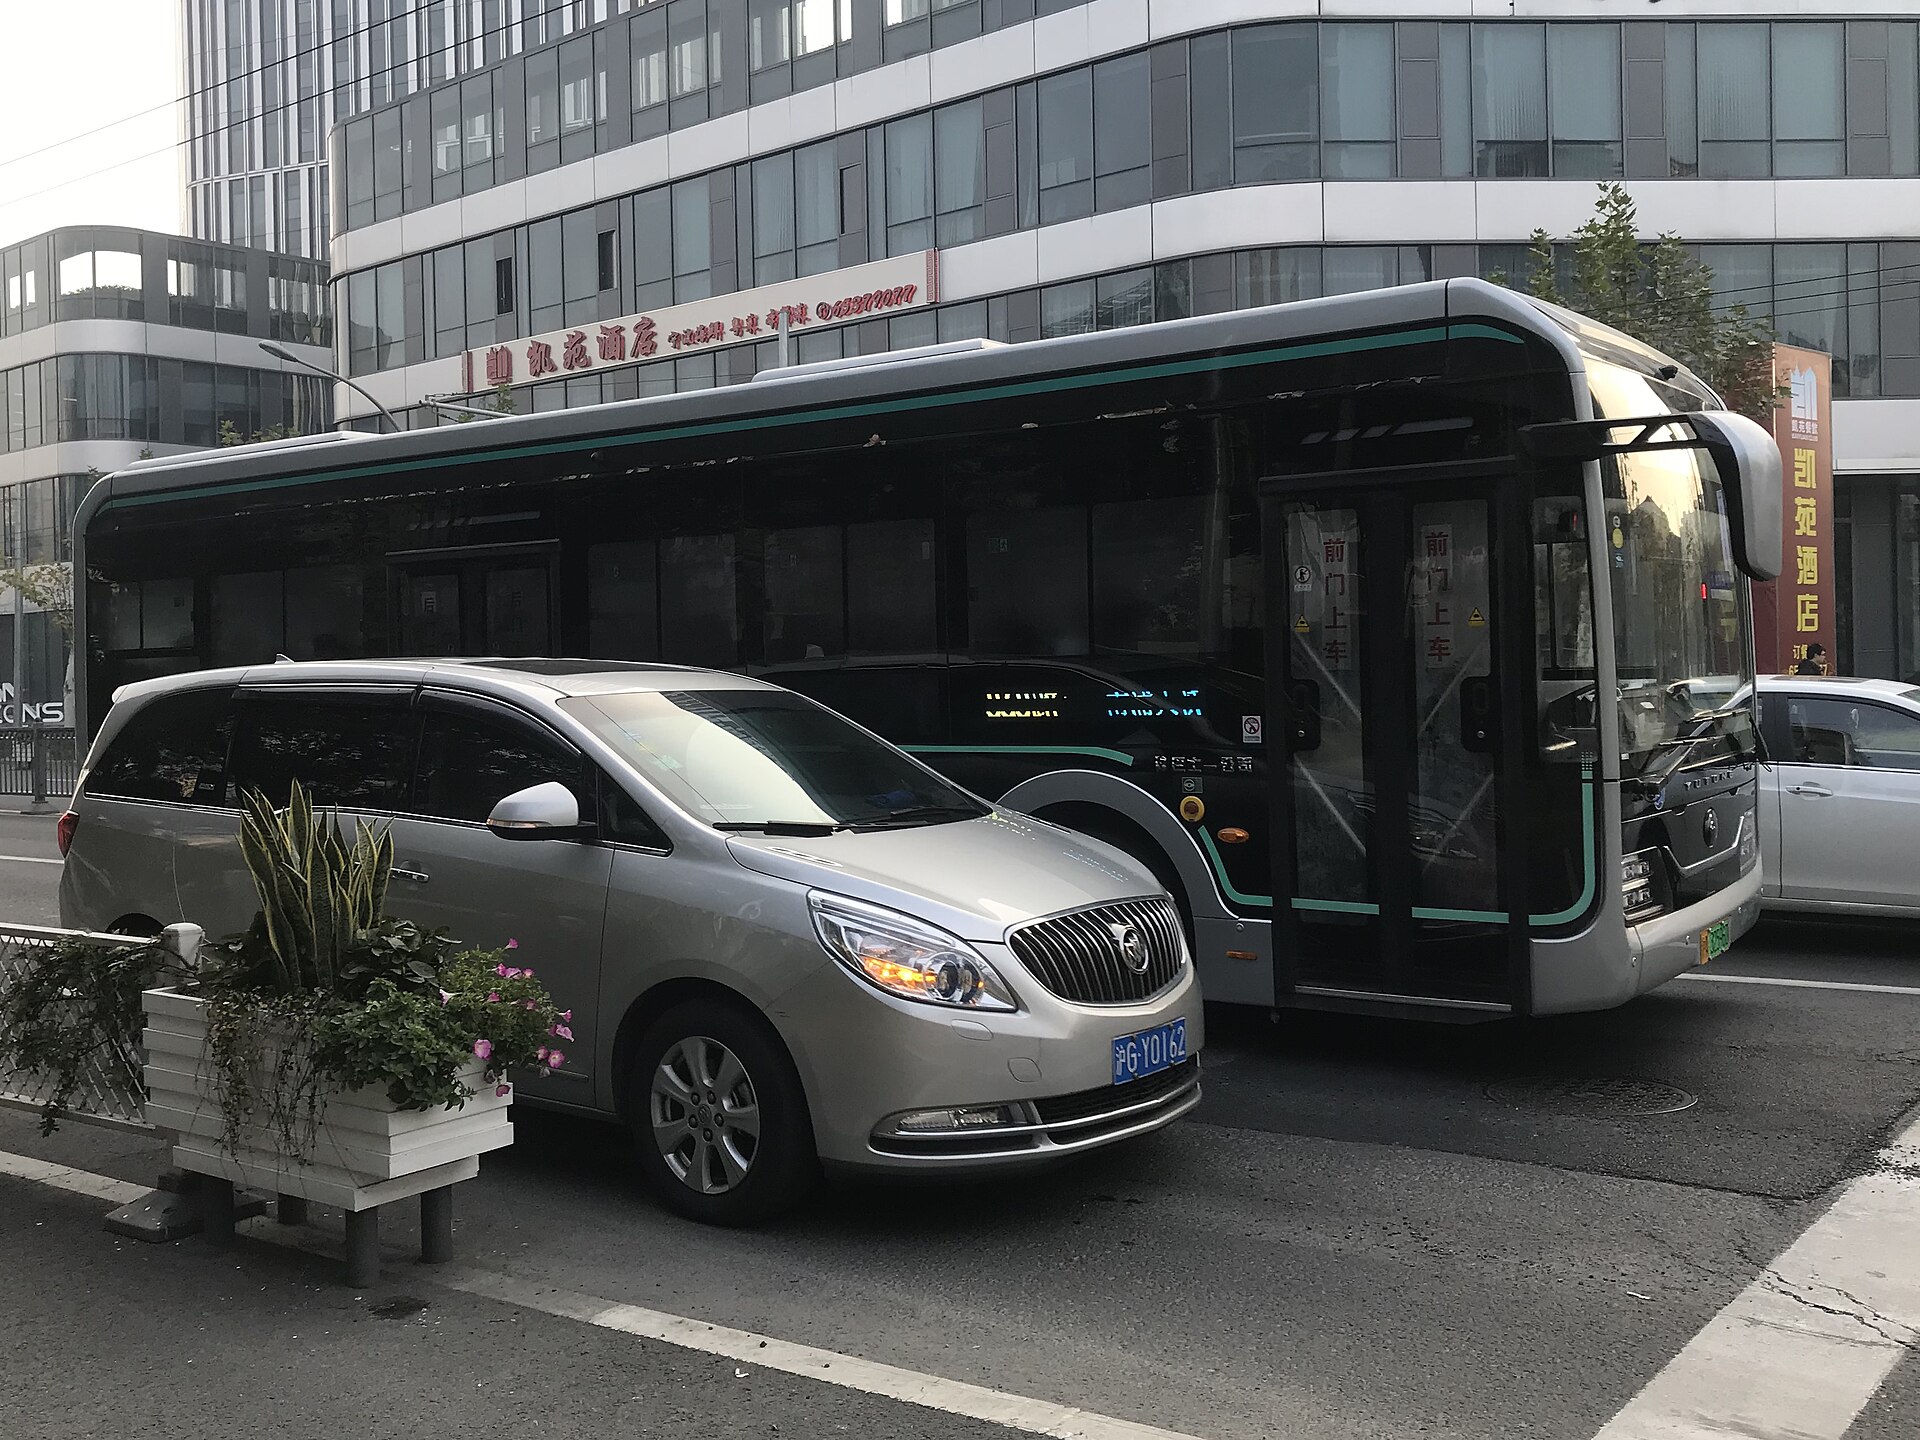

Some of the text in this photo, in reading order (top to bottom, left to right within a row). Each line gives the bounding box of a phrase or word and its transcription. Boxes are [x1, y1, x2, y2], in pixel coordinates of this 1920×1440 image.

[527, 315, 658, 377] 凯苑酒店
[1323, 538, 1347, 664] 前门上车
[1422, 531, 1450, 662] 前门上车
[1794, 447, 1819, 632] 凯苑酒店
